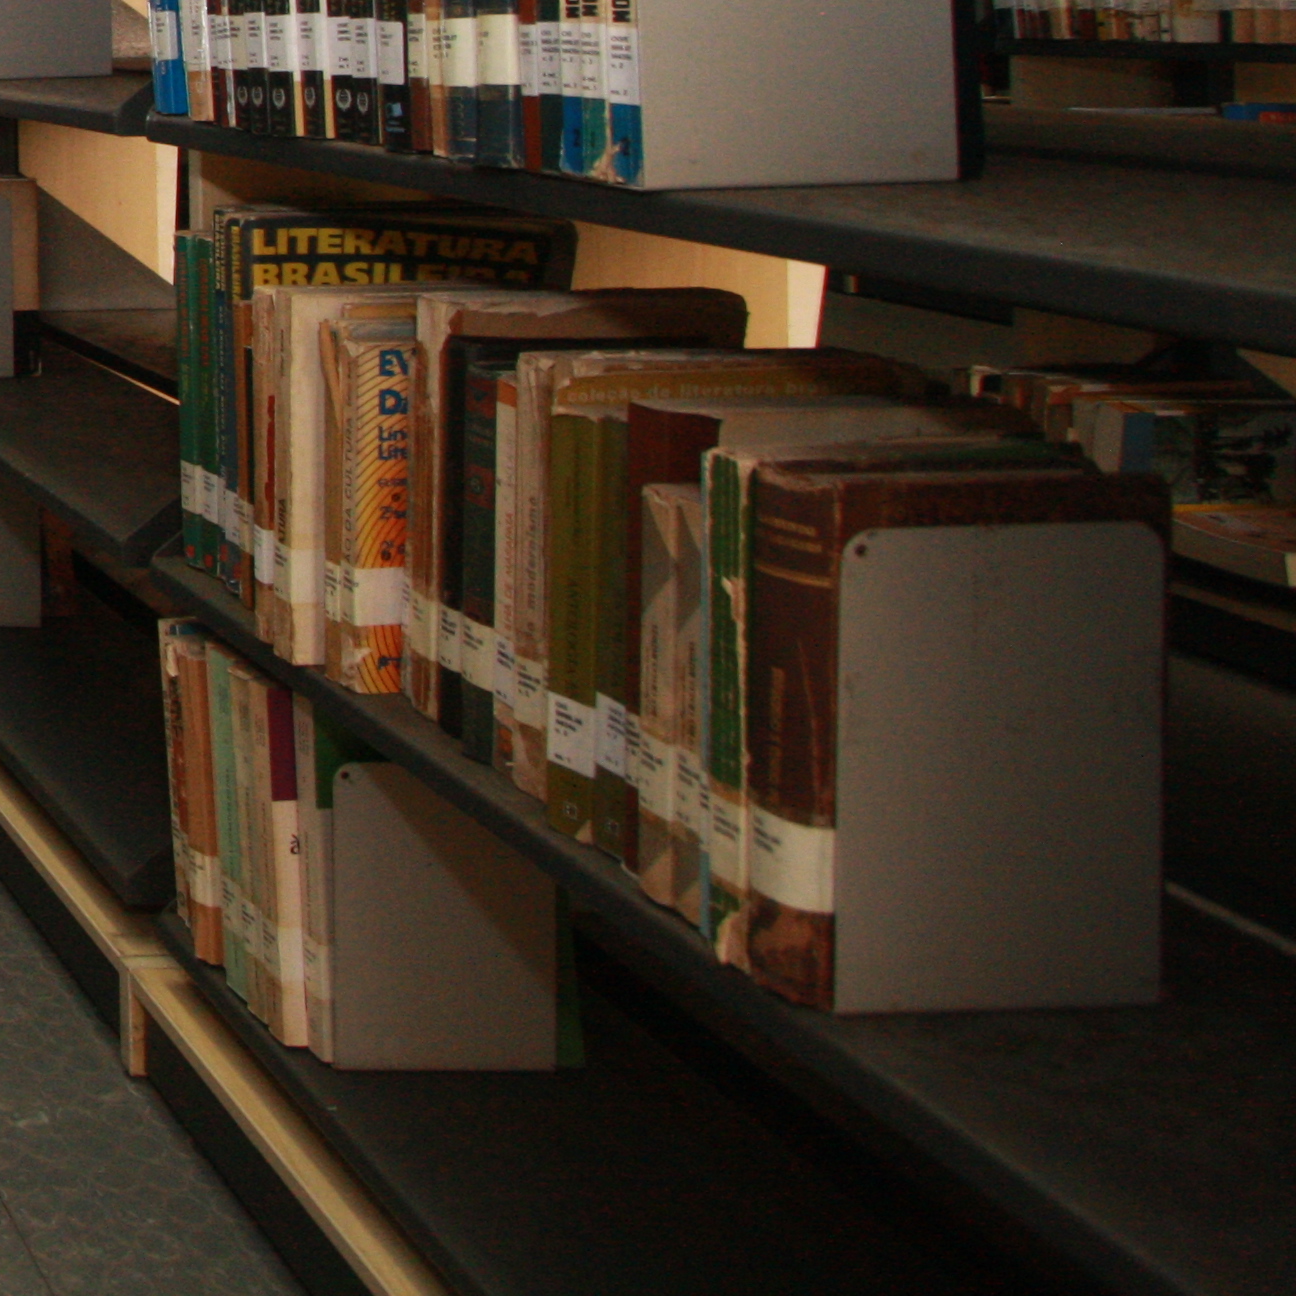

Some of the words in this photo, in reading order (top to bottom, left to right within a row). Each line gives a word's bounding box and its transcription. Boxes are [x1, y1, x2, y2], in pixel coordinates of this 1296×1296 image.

[252, 227, 539, 266] LITERATURA
[566, 389, 639, 406] coleção
[679, 384, 775, 399] literatura
[343, 417, 353, 500] CULTURA
[525, 495, 537, 609] modernismo
